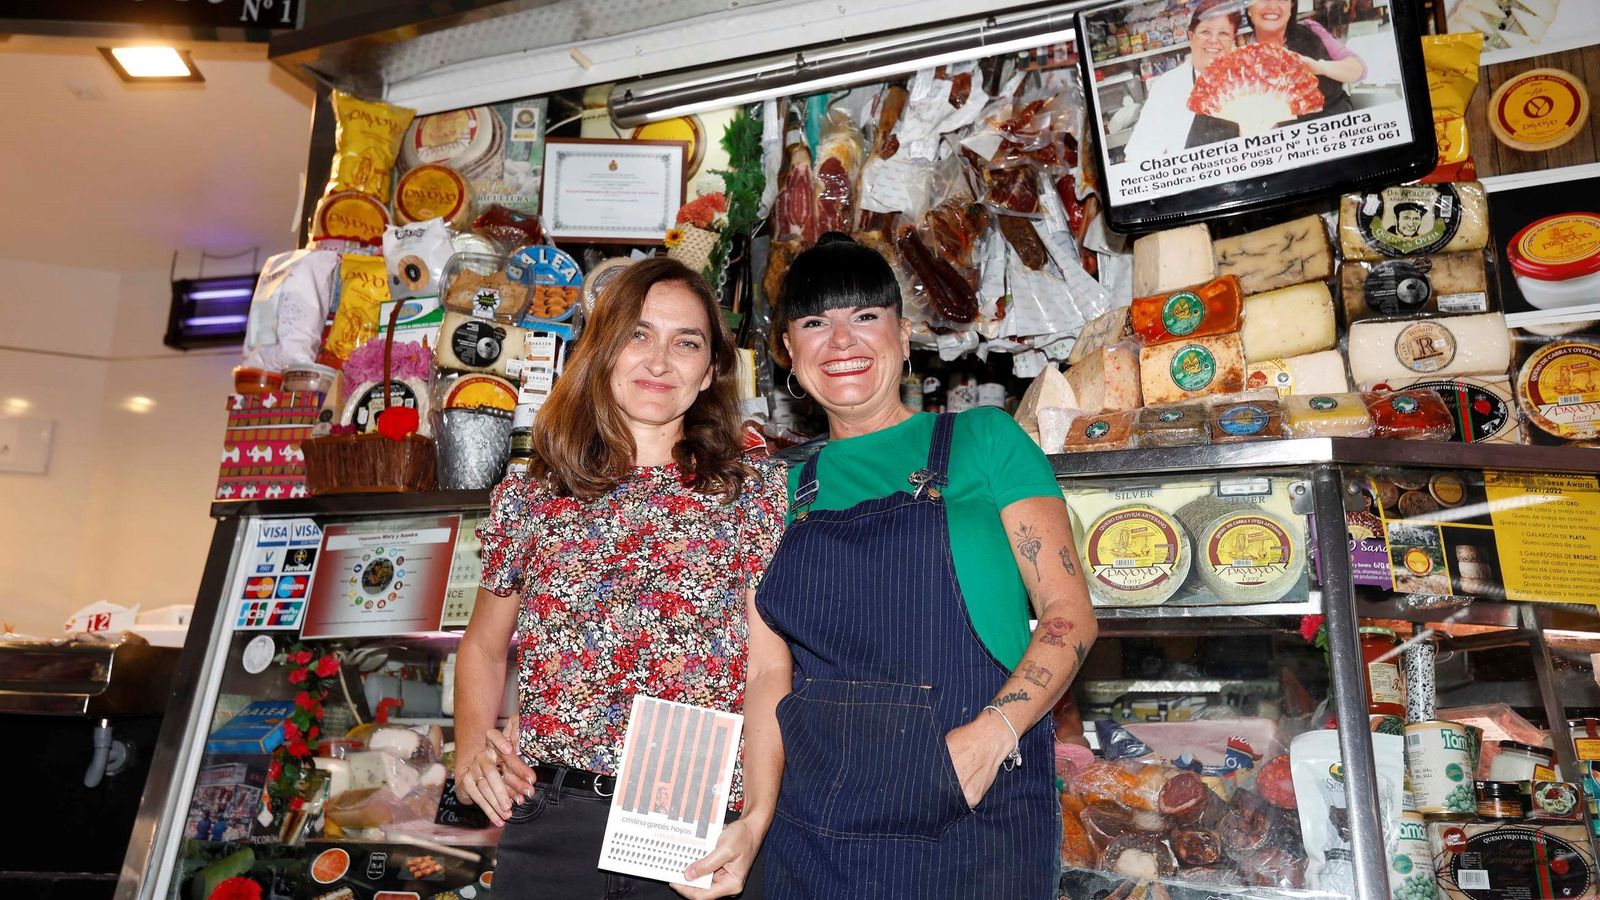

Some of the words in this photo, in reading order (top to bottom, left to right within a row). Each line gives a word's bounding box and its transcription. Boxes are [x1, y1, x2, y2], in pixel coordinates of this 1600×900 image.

[280, 0, 291, 23] 1
[1140, 142, 1239, 172] Charcutería
[1245, 129, 1285, 149] Mari
[1291, 129, 1301, 138] y
[1307, 113, 1372, 135] Sandra
[1121, 168, 1170, 187] Mercado
[1173, 166, 1188, 176] De
[1191, 156, 1238, 172] Abastos
[1242, 146, 1283, 161] Puesto
[1286, 140, 1301, 150] Nº
[1307, 135, 1328, 146] 116
[1339, 120, 1398, 139] Algeciras
[1119, 184, 1149, 197] Telf.:
[1152, 175, 1196, 190] Sandra:
[1199, 169, 1221, 180] 670
[1226, 163, 1247, 174] 106
[1250, 157, 1273, 169] 098
[1288, 147, 1320, 161] Mari:
[1323, 141, 1347, 153] 678
[1351, 135, 1375, 147] 778
[1378, 129, 1401, 141] 061
[1415, 231, 1440, 246] OVEJA
[1573, 346, 1593, 354] OVEJA
[1567, 480, 1594, 489] Awards
[1115, 491, 1154, 501] SILVER
[1224, 495, 1266, 505] SILVER
[1100, 517, 1115, 531] QUESO
[1141, 512, 1167, 529] ARTESANO
[264, 526, 288, 538] VISA
[295, 524, 320, 537] VISA
[1107, 567, 1158, 580] PAYOYO
[1227, 566, 1274, 578] PAYOYO
[88, 612, 111, 632] 12
[621, 816, 646, 827] cristina
[646, 821, 670, 831] garcés
[670, 825, 692, 835] hoyos
[1483, 835, 1503, 844] QUESO
[1529, 835, 1548, 845] OVEJA
